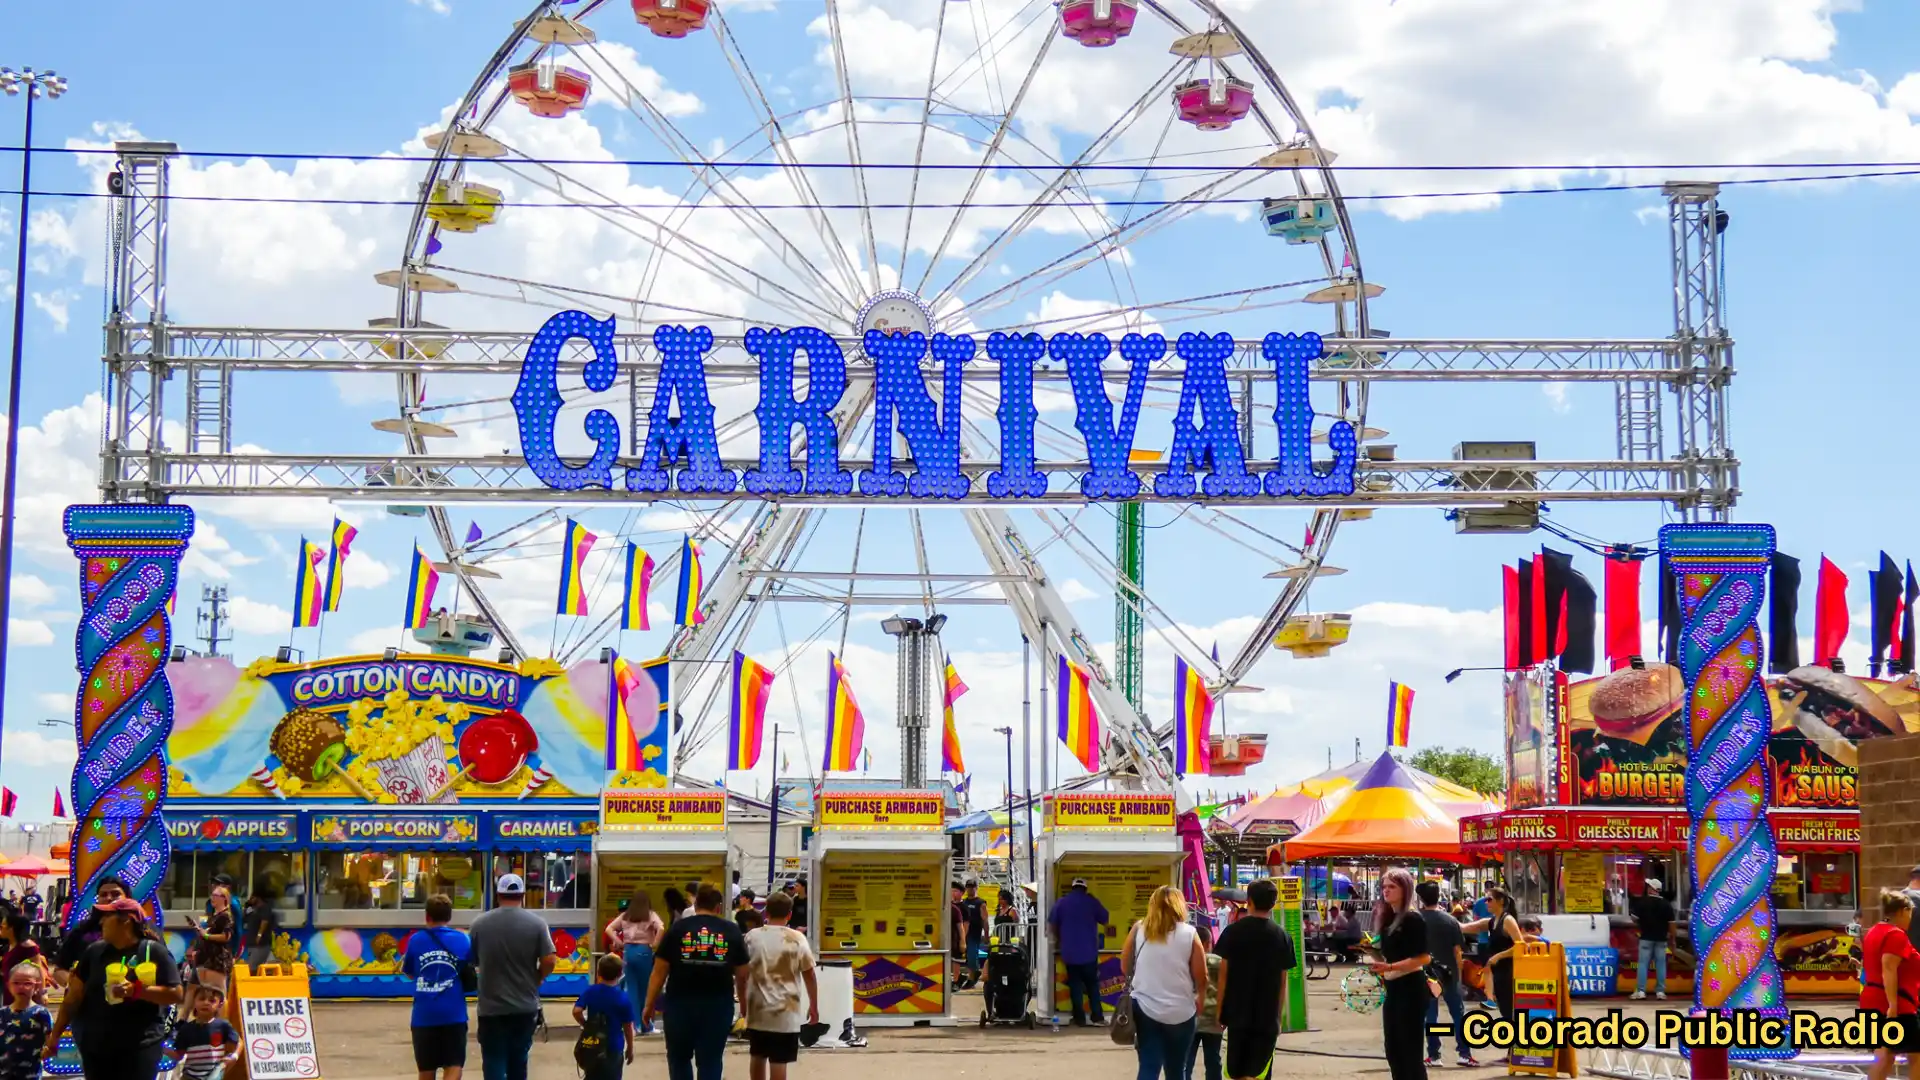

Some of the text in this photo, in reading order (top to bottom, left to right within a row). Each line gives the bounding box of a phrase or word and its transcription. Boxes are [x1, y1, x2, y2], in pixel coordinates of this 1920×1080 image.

[511, 309, 1358, 500] CARNIVAL
[88, 563, 165, 642] FOOD
[1690, 579, 1754, 653] FOOD
[292, 664, 517, 704] COTTON CANDY!
[1558, 684, 1569, 784] FRIES
[84, 700, 163, 789] RIDES
[1695, 708, 1763, 792] RIDES
[1619, 763, 1638, 771] HOT
[1650, 763, 1678, 771] JUICY
[1791, 766, 1800, 774] IN
[1803, 766, 1810, 774] A
[1812, 766, 1832, 774] BUN
[1599, 772, 1685, 797] BURGER
[1797, 774, 1859, 800] SAUS
[607, 800, 722, 813] PURCHASE ARMBAND
[825, 801, 938, 814] PURCHASE ARMBAND
[1060, 802, 1170, 815] PURCHASE ARMBAND
[656, 814, 672, 822] Here
[1108, 815, 1123, 823] Here
[1511, 818, 1543, 826] ICE COLD
[166, 820, 287, 836] NDY APPLES
[499, 820, 576, 837] CARAMEL
[1504, 825, 1556, 838] DRINKS
[1578, 825, 1659, 838] CHEESESTEAK
[1779, 828, 1860, 840] FRENCH FRIES
[1701, 840, 1770, 928] GAMES
[246, 999, 304, 1016] PLEASE
[247, 1023, 281, 1034] NO RUNNING
[277, 1042, 312, 1054] NO BICYCLES
[253, 1061, 295, 1073] NO SKATEBOARDS
